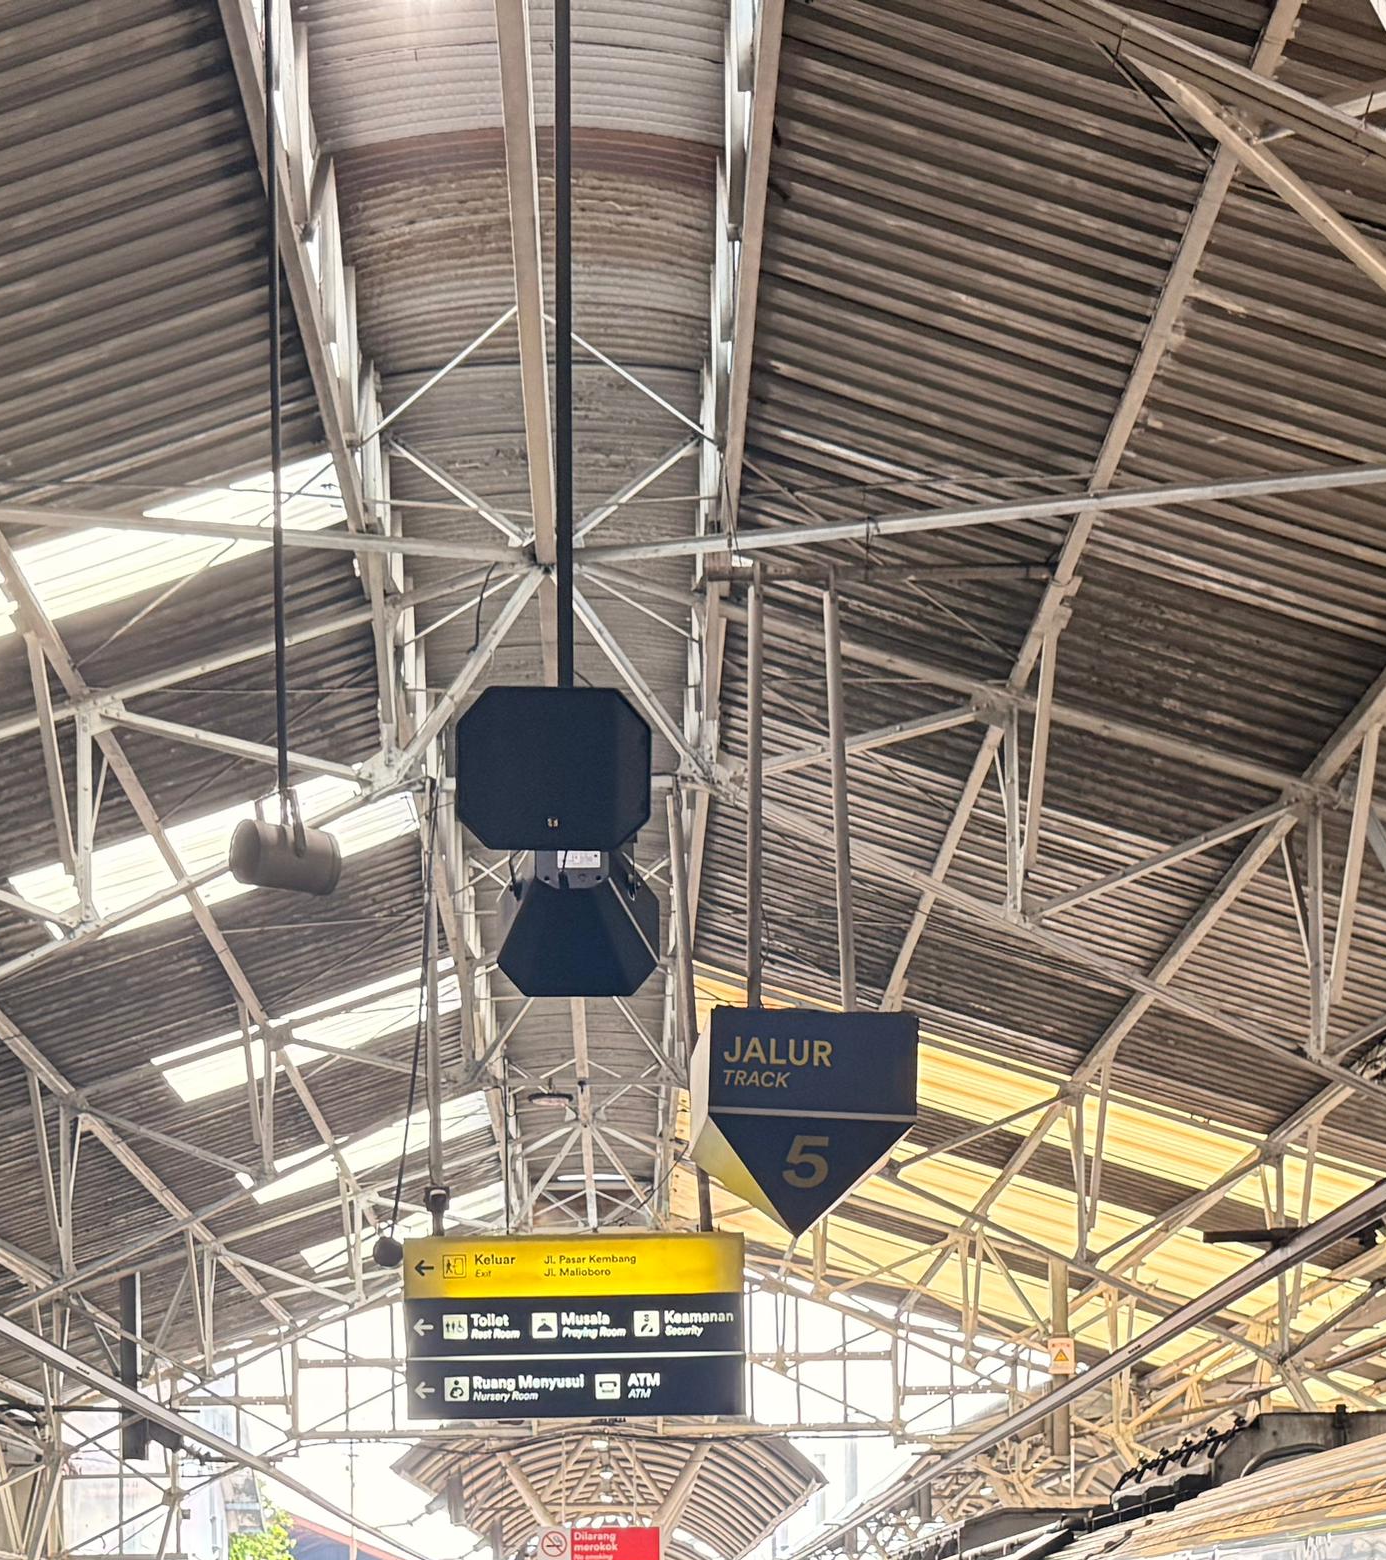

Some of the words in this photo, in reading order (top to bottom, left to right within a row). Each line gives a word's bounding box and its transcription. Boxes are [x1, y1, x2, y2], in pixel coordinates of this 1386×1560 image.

[723, 1036, 833, 1068] JALUR
[723, 1069, 791, 1088] TRACK
[781, 1134, 830, 1189] 5
[474, 1253, 516, 1265] Keluar
[543, 1255, 556, 1265] Jl.
[559, 1255, 586, 1264] Pasar
[589, 1254, 637, 1265] Kembang
[475, 1269, 492, 1278] Exit
[543, 1268, 556, 1277] Jl.
[559, 1267, 611, 1277] Malioboro
[470, 1312, 510, 1327] Toilet
[561, 1311, 611, 1326] Musala
[664, 1309, 734, 1324] Keamanan
[470, 1328, 493, 1339] Rest
[493, 1328, 521, 1339] Room
[562, 1326, 598, 1340] Praying
[599, 1326, 627, 1338] Room
[664, 1324, 704, 1337] Security
[472, 1375, 516, 1391] Ruang
[518, 1373, 585, 1391] Menyusui
[627, 1372, 661, 1387] ATM
[473, 1391, 511, 1403] Nursery
[512, 1391, 539, 1401] Room
[628, 1388, 652, 1399] ATM
[573, 1531, 617, 1542] Dilarang
[573, 1542, 618, 1551] merokok
[574, 1553, 584, 1560] No
